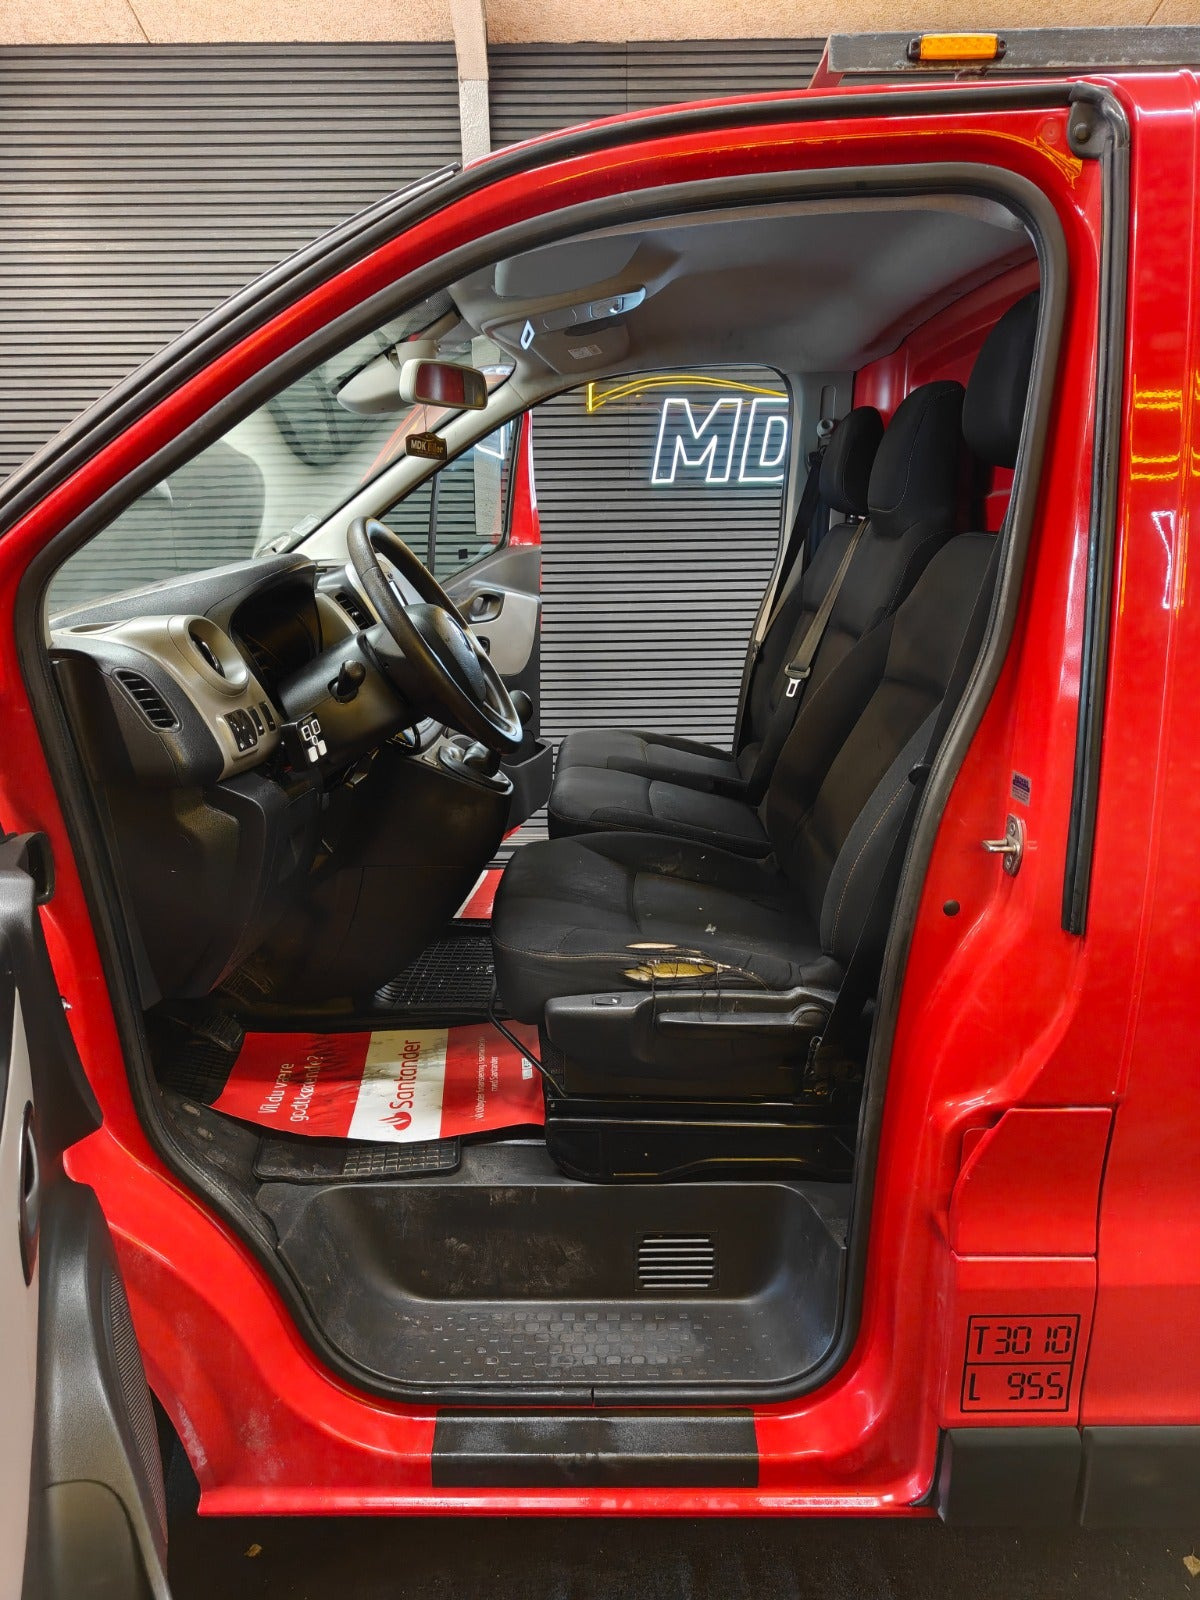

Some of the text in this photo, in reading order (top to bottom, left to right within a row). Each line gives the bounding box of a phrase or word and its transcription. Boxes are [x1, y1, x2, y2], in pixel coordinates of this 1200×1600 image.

[410, 439, 427, 451] MDK
[258, 1063, 295, 1114] Vil du være
[389, 1040, 421, 1109] Santander
[968, 1371, 1064, 1401] L 955
